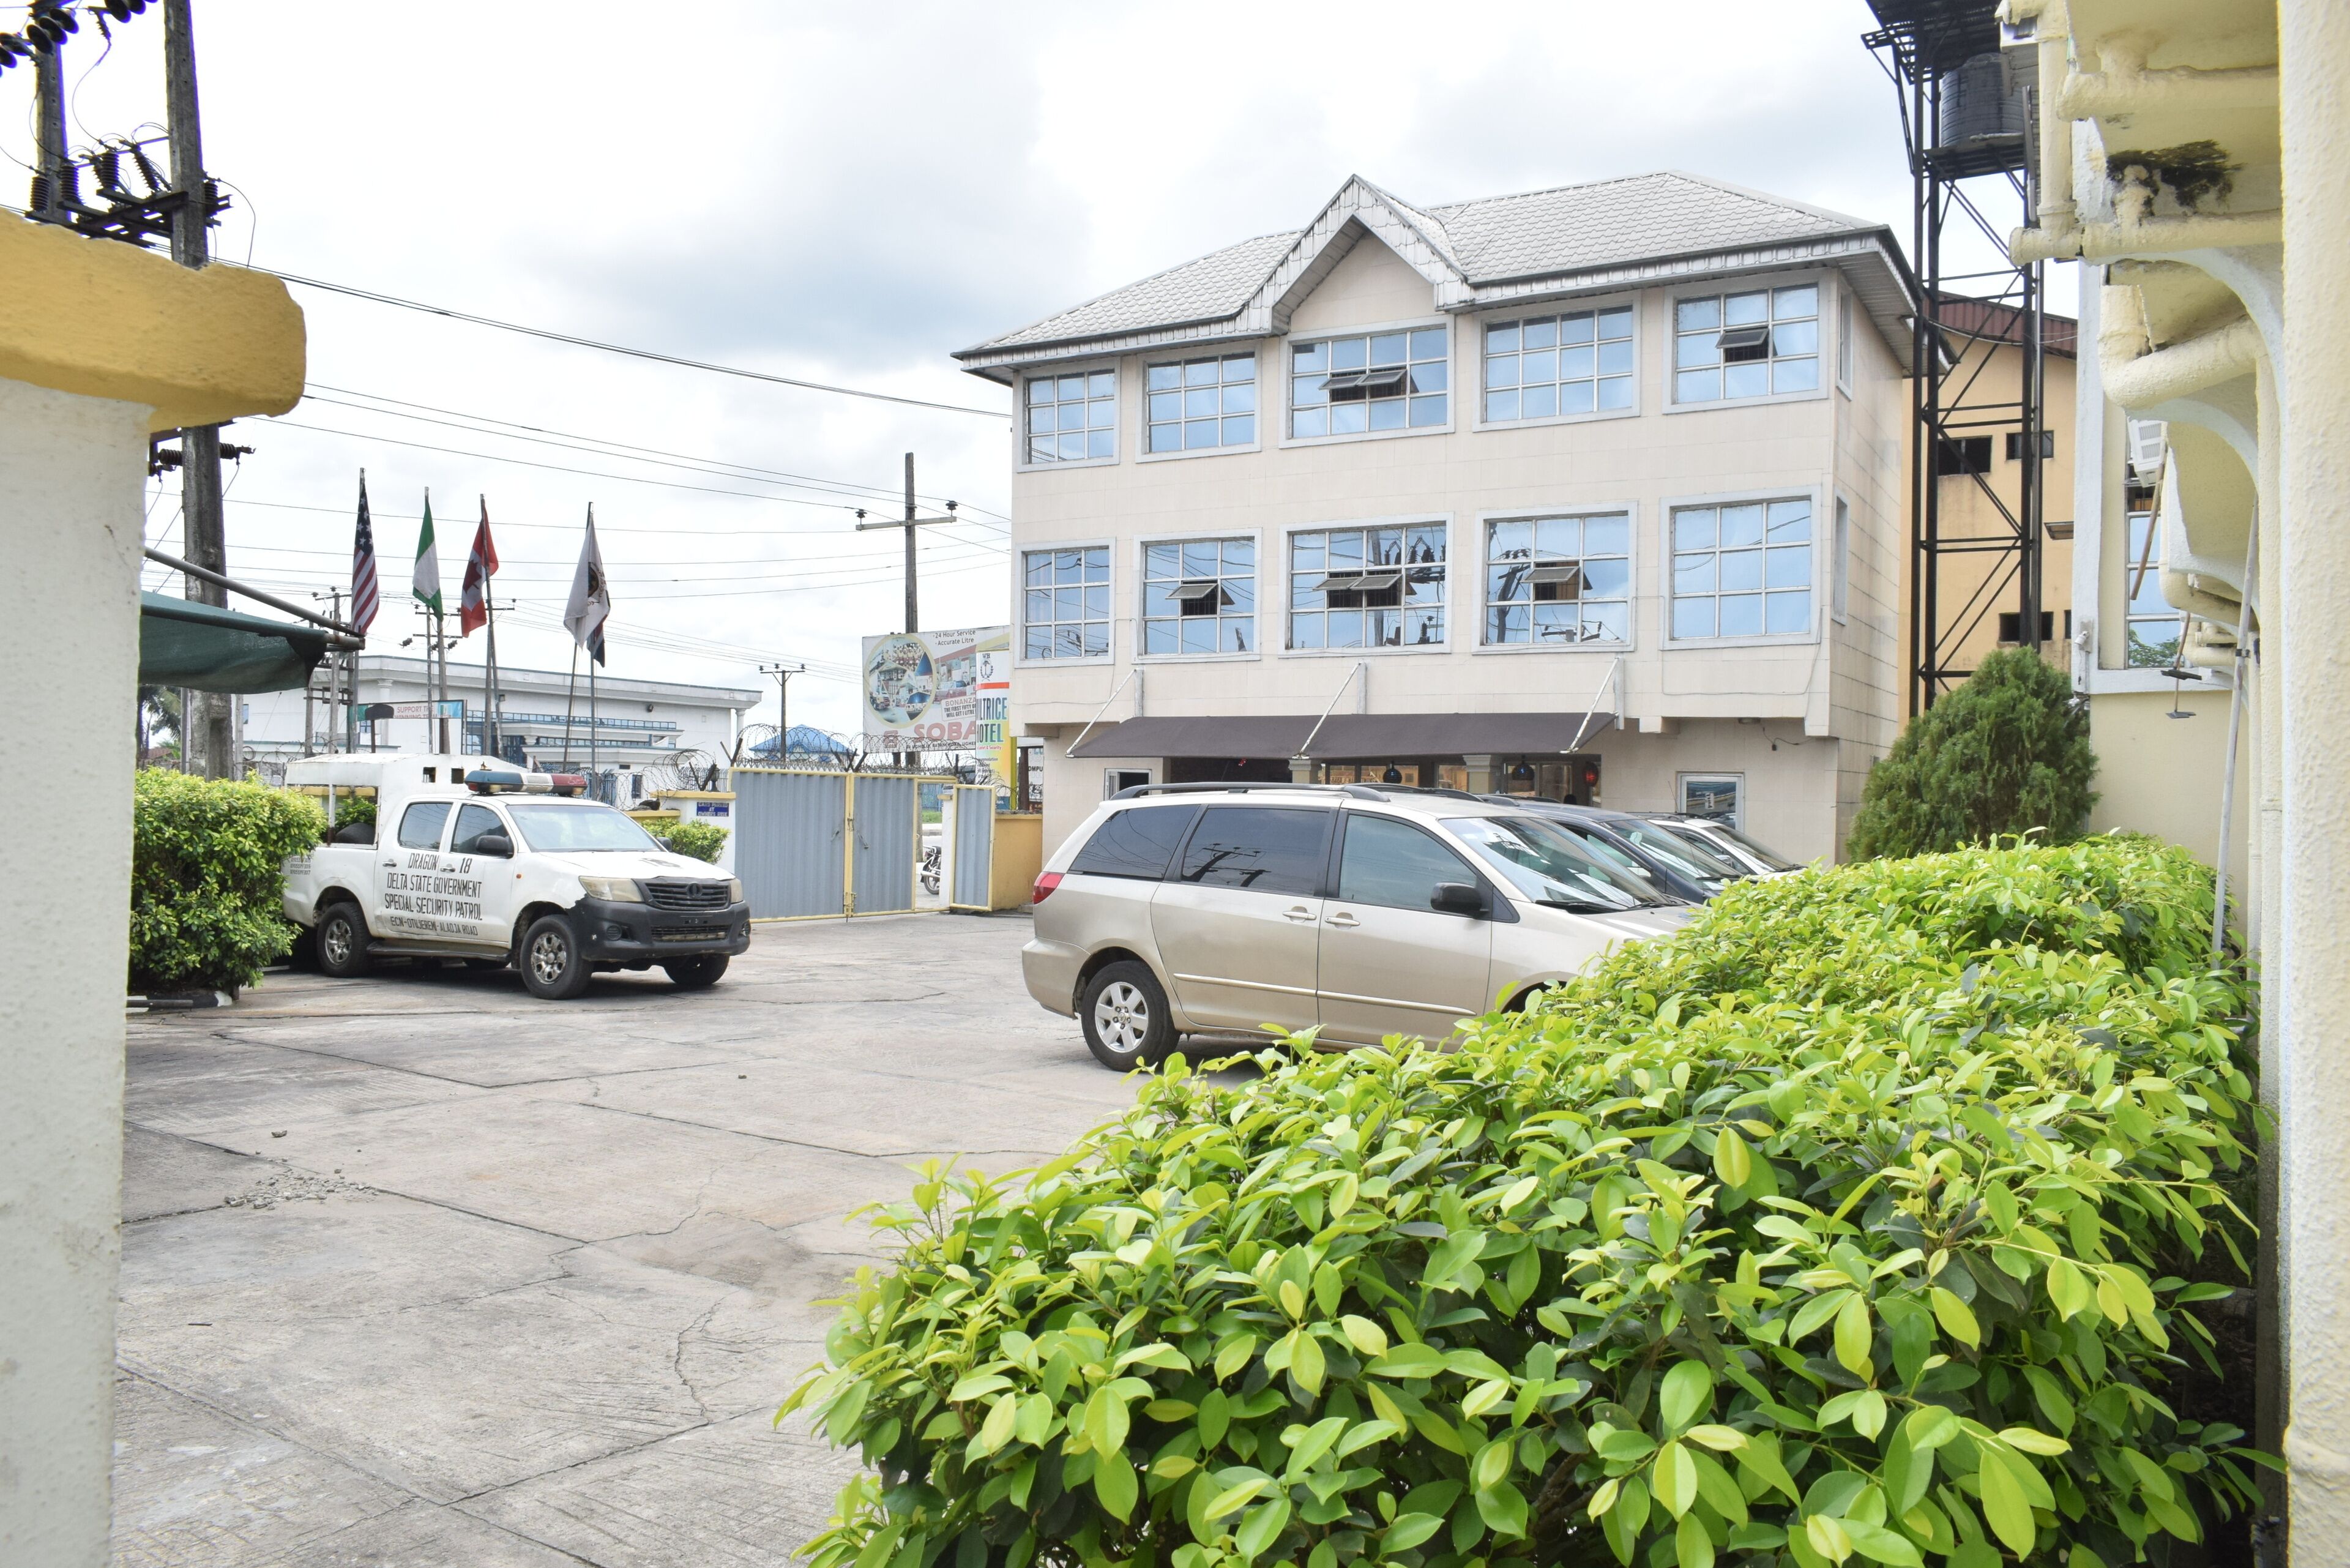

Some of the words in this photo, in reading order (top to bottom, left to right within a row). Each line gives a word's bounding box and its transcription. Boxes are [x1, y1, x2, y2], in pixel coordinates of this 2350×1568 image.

[945, 697, 976, 707] BONANZA
[408, 853, 439, 870] DRAGON
[460, 857, 472, 874] 18
[387, 872, 408, 890] DELTA
[410, 875, 432, 893] STATE
[433, 876, 482, 898] GOVERNMENT
[384, 893, 414, 913] SPECIAL
[416, 897, 453, 917] SECURITY
[455, 901, 483, 920] PATROL
[462, 925, 479, 936] ROAD
